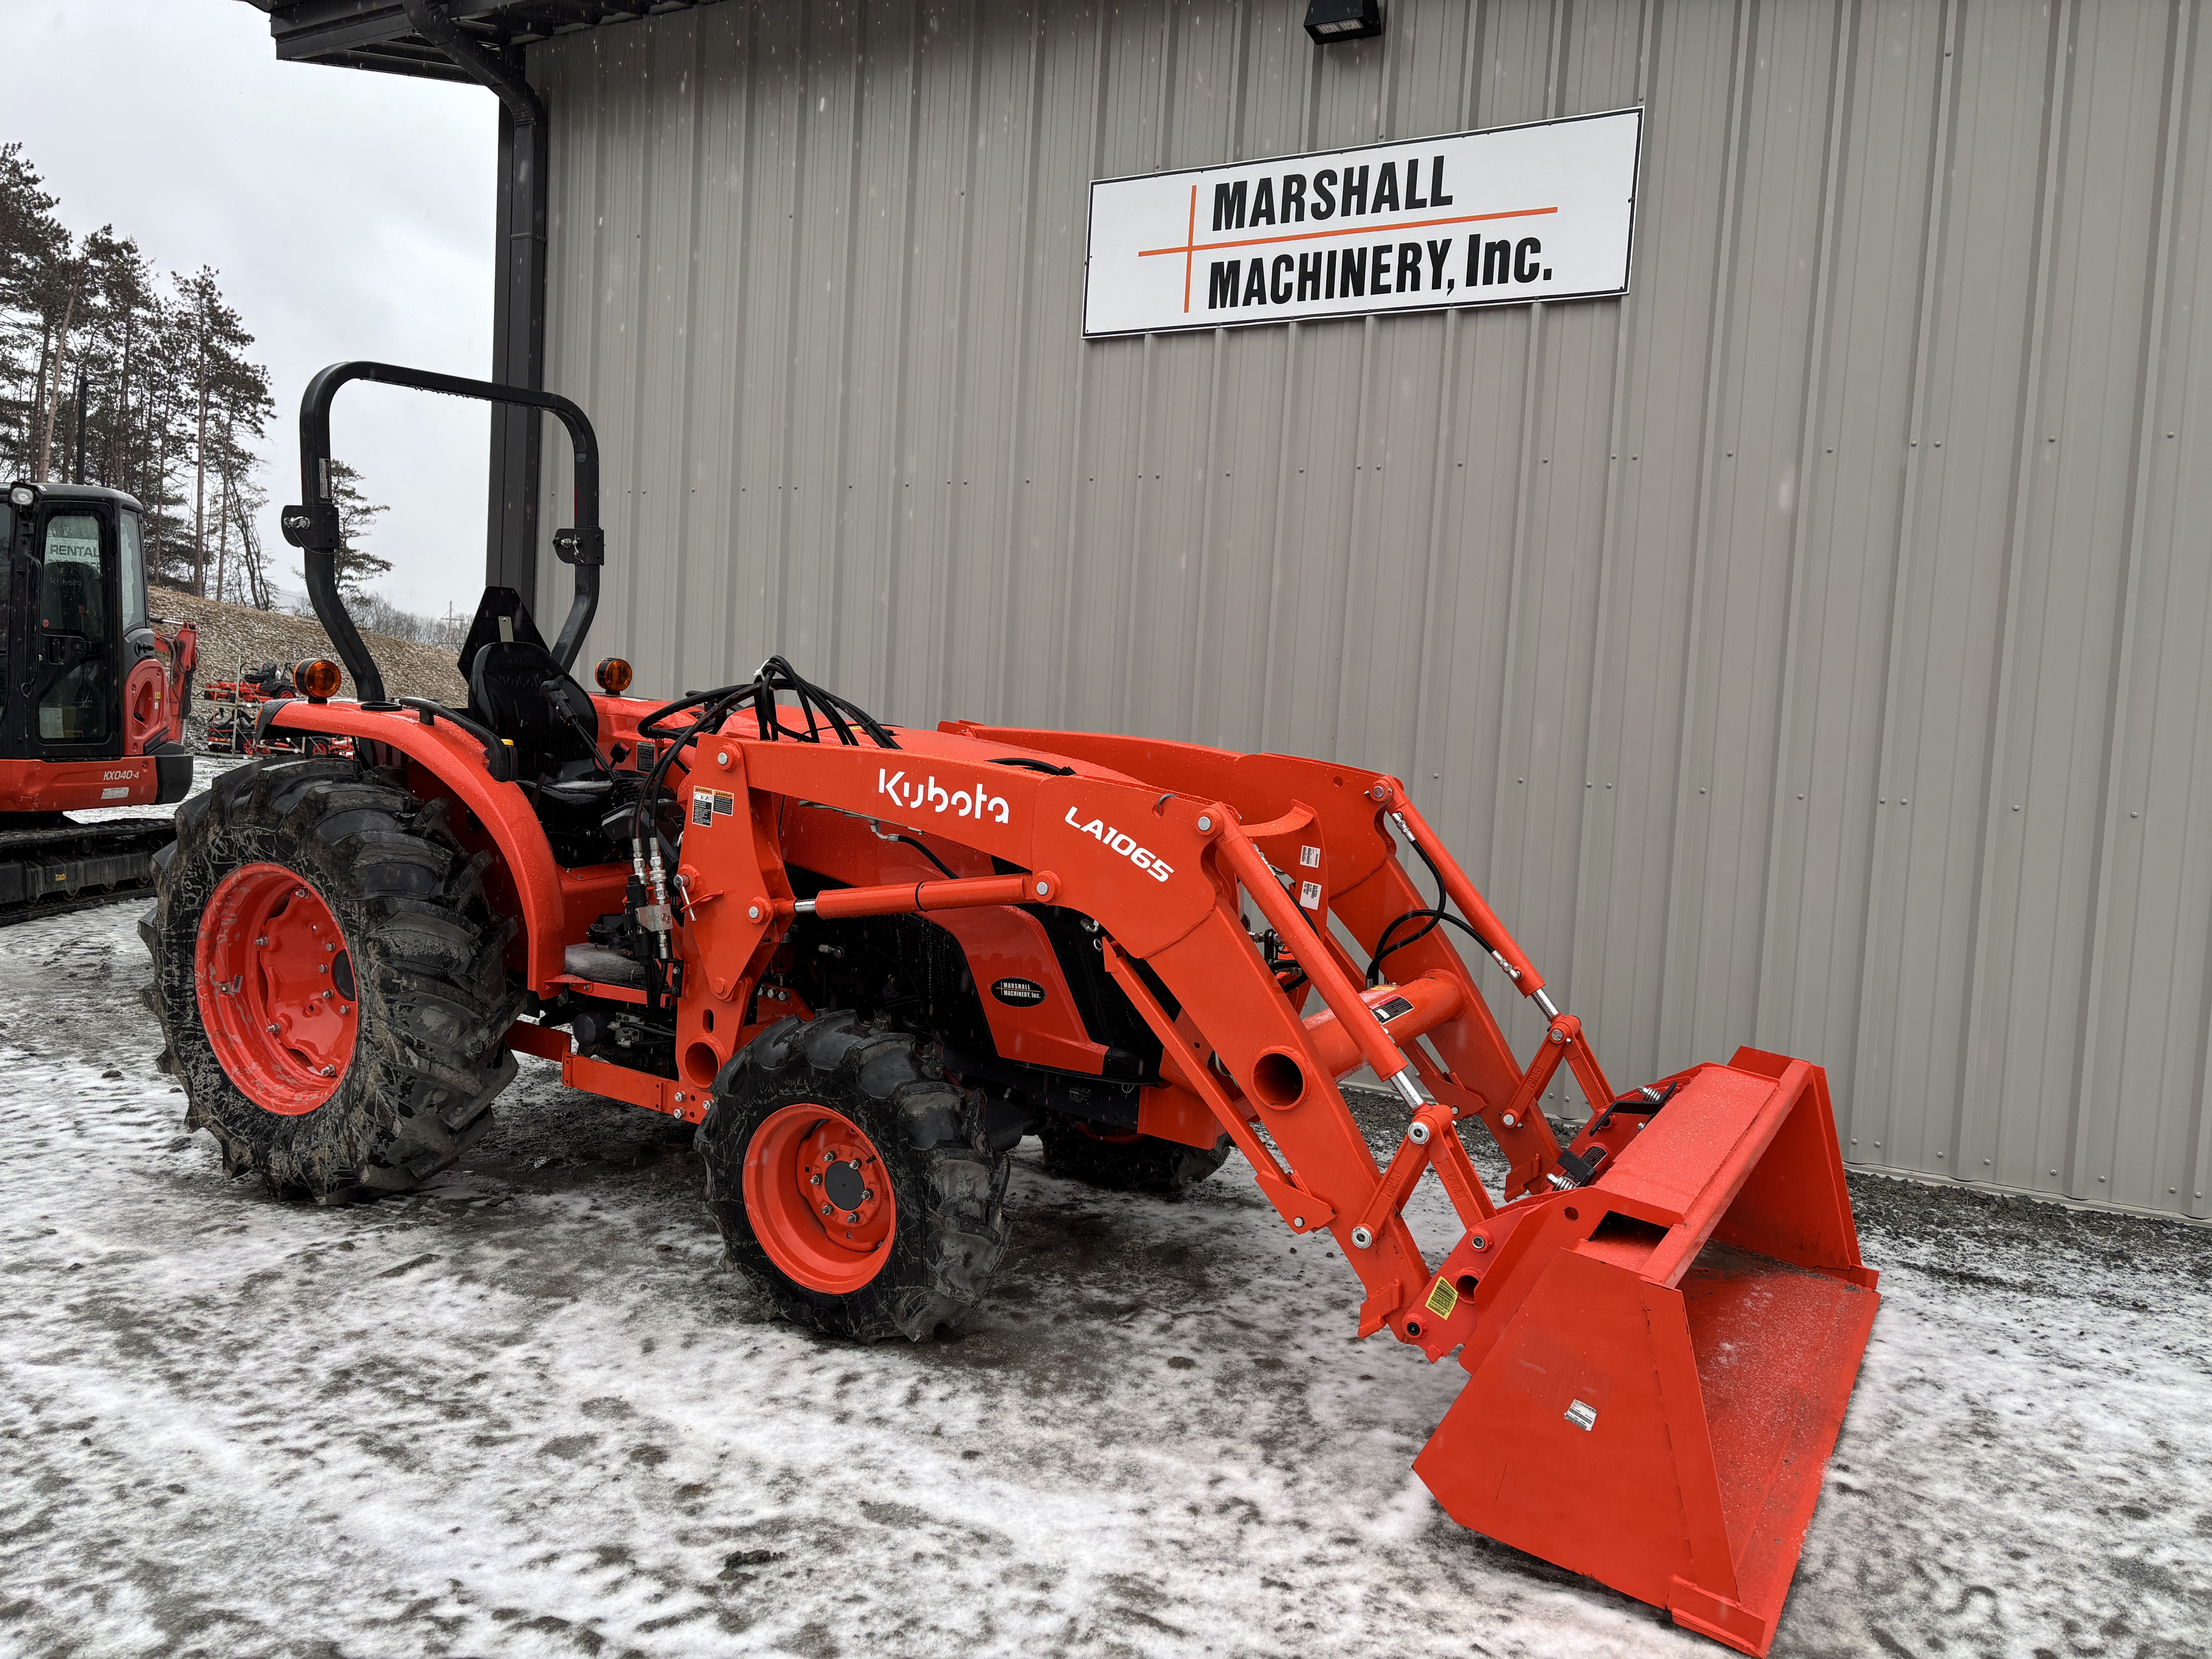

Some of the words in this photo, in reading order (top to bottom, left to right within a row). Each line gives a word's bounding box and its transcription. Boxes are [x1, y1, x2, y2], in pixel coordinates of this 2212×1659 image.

[1212, 155, 1453, 232] MARSHALL
[1208, 238, 1455, 310] MACHINERY,
[1465, 233, 1552, 287] Inc.
[50, 544, 100, 558] RENTAL
[103, 770, 139, 781] KX040-4
[878, 768, 1009, 824] Kubota
[1064, 806, 1175, 882] LA1065
[1003, 982, 1030, 990] MARSHALL
[1003, 990, 1031, 998] MACHINERY,
